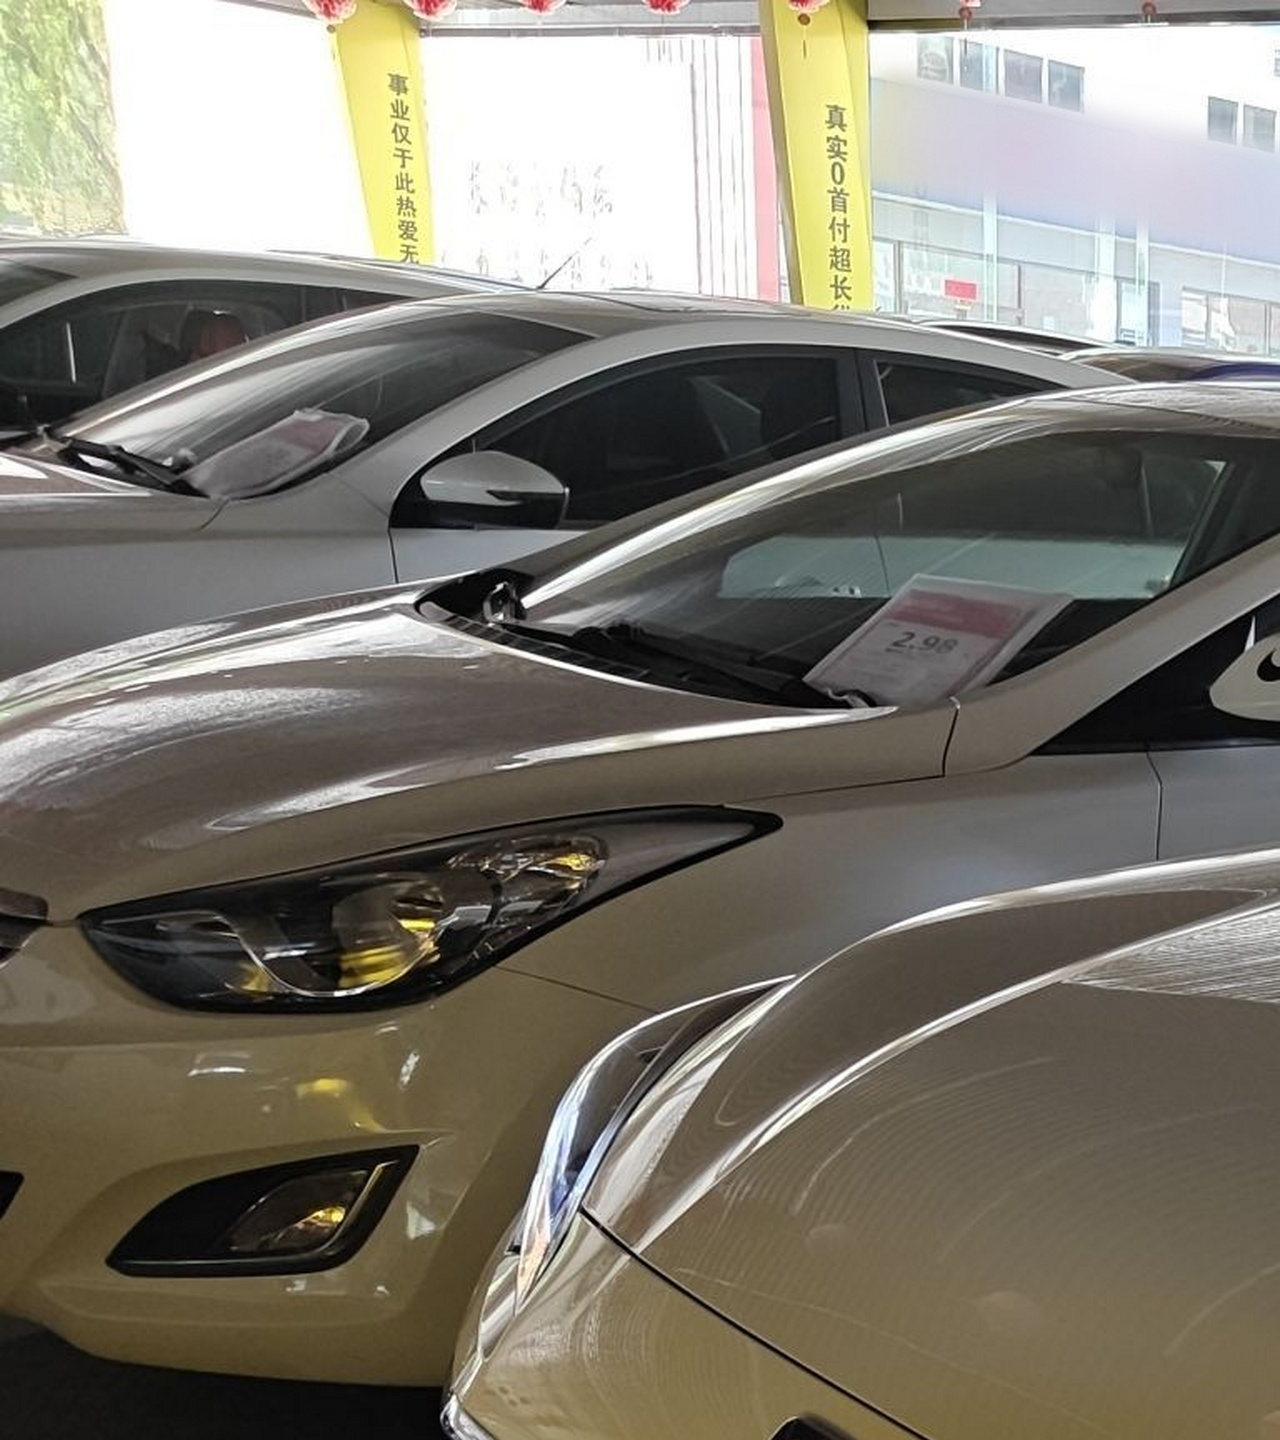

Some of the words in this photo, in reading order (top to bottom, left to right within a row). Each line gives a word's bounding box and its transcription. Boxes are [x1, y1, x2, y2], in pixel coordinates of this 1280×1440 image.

[387, 72, 420, 265] 事业仅于此热爱无
[824, 104, 853, 311] 真实0首付超长
